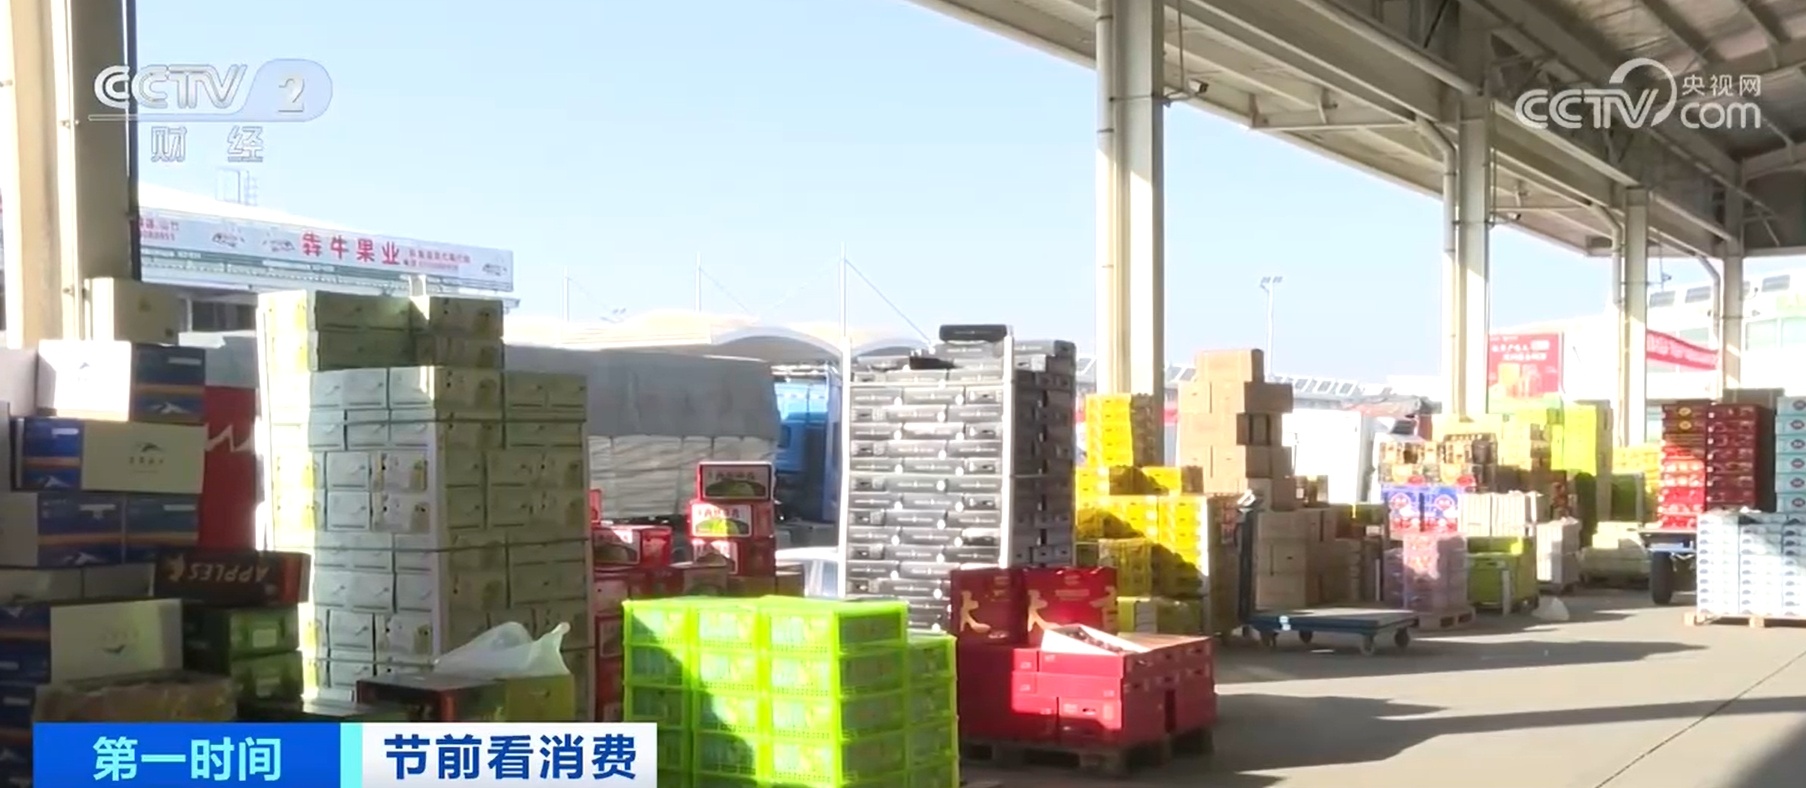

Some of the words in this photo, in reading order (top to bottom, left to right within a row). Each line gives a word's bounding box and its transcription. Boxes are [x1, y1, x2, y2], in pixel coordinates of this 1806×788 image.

[302, 231, 400, 266] 犇牛果业
[187, 562, 269, 583] APPLES
